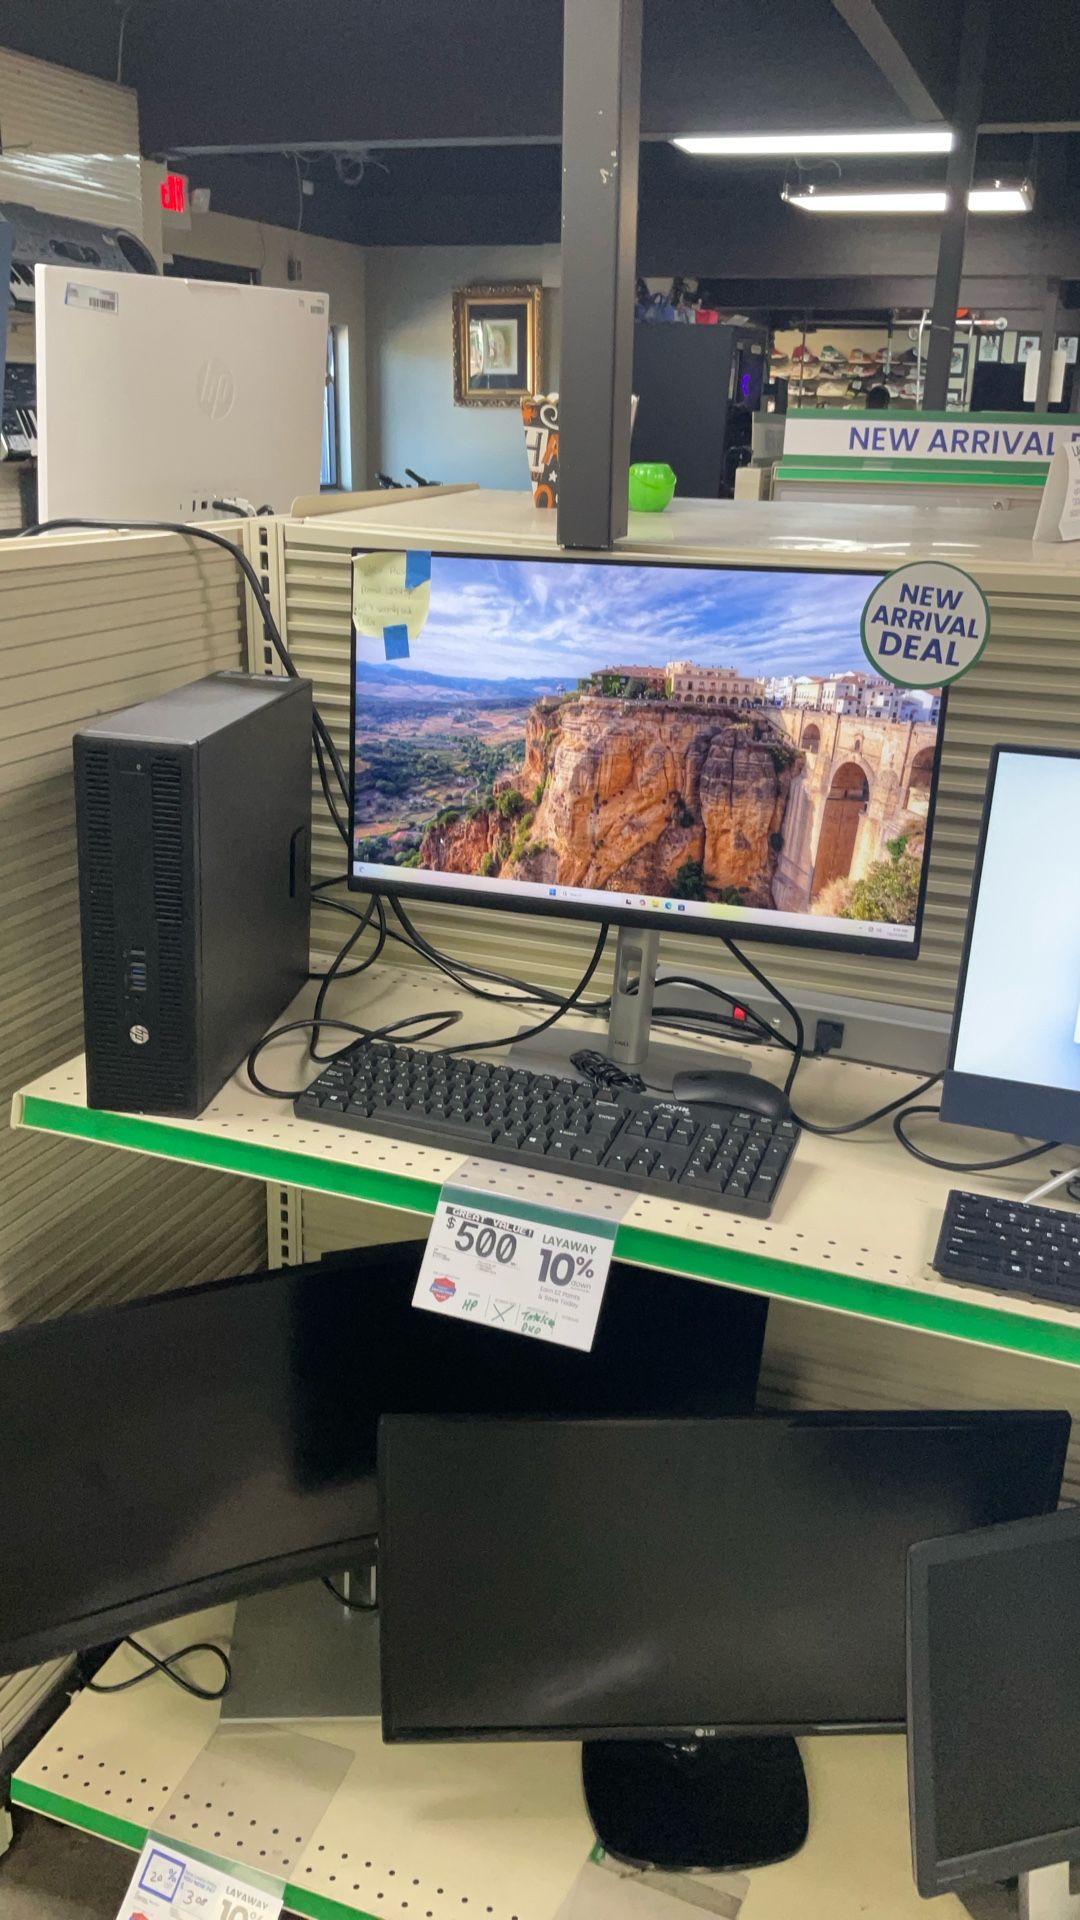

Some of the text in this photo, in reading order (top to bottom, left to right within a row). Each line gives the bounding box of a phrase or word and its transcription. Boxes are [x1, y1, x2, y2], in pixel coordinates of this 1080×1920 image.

[849, 427, 920, 451] NEW
[927, 428, 1055, 456] ARRIVAL
[899, 583, 963, 610] NEW
[871, 605, 978, 639] ARRIVAL
[878, 630, 959, 667] DEAL
[453, 1207, 485, 1223] GREAT
[542, 1234, 597, 1255] LAYAWAY
[538, 1248, 594, 1287] 10%
[462, 1298, 478, 1311] HP
[226, 1886, 269, 1910] LAYAWAY
